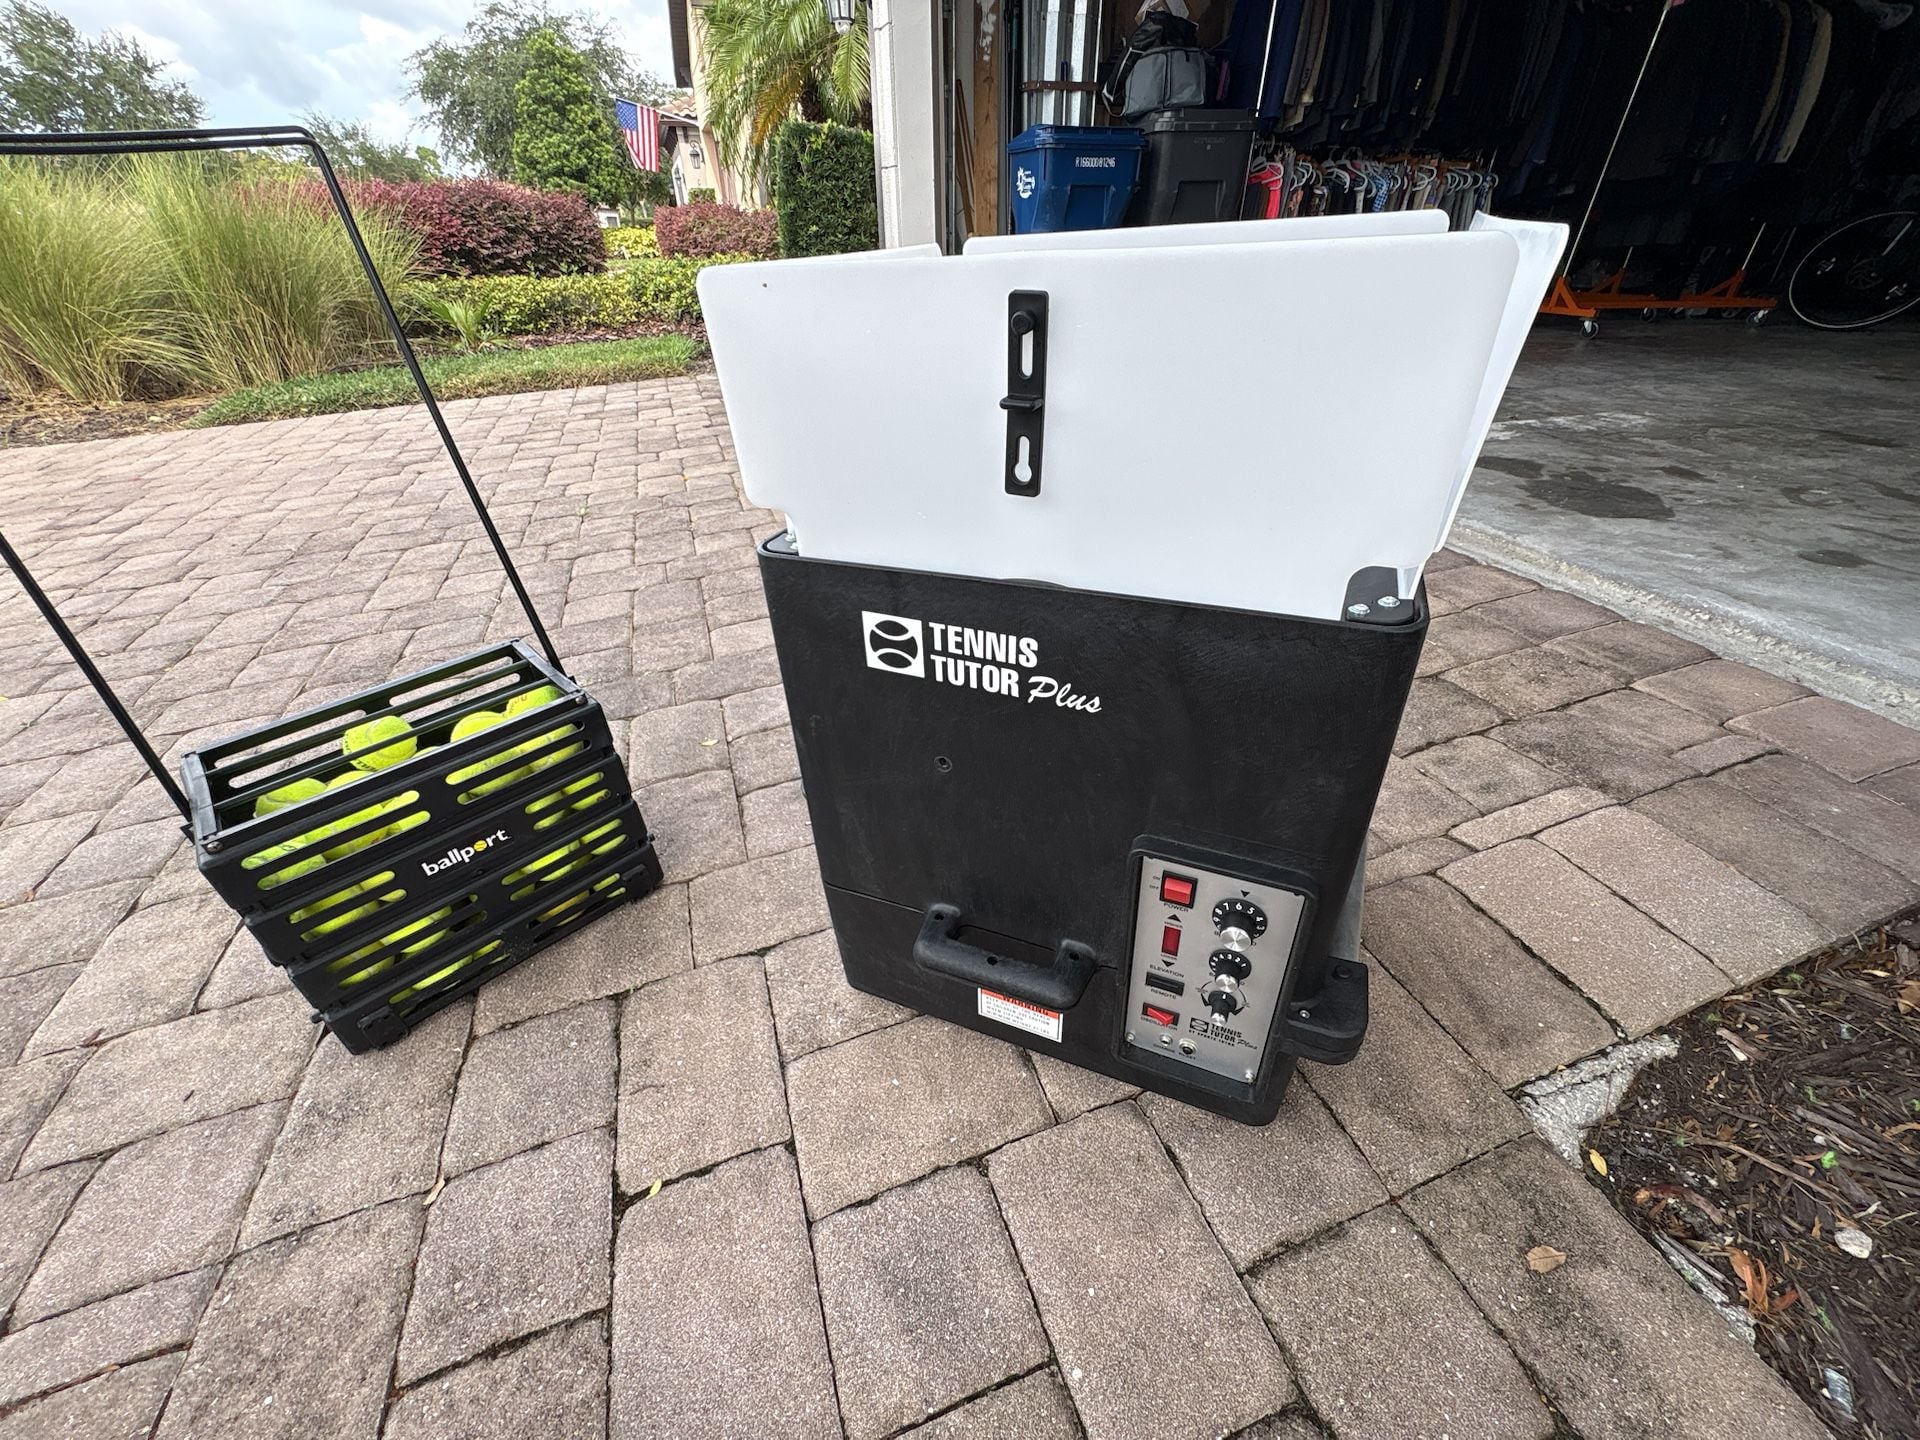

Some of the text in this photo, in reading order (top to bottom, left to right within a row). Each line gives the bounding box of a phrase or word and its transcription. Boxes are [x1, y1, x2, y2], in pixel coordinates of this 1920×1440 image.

[928, 621, 1039, 668] TENNIS
[930, 654, 1102, 713] TUTOR Plus
[421, 829, 509, 876] ballport
[1163, 902, 1189, 913] POWER
[1222, 902, 1229, 910] 7
[1235, 902, 1242, 911] 6
[1247, 907, 1255, 915] 5
[1149, 964, 1185, 979] ELEVATION
[1150, 988, 1177, 999] REMOTE
[1210, 1029, 1236, 1042] TUTOR
[1212, 1023, 1242, 1038] TENNIS
